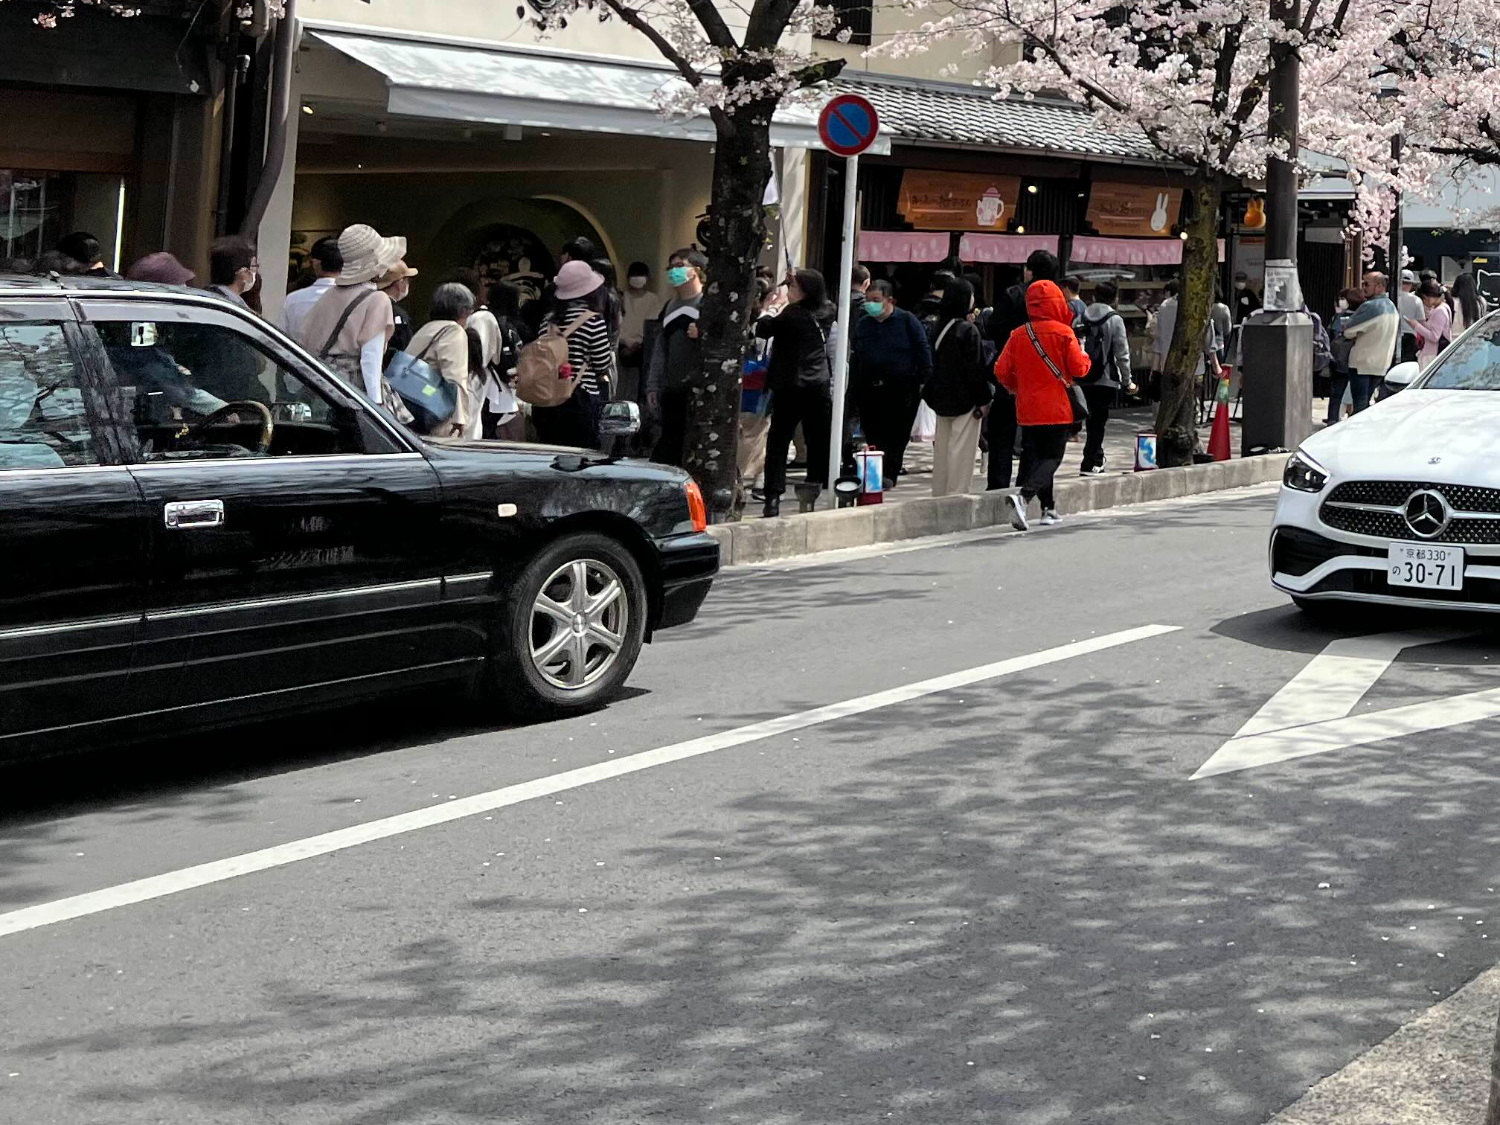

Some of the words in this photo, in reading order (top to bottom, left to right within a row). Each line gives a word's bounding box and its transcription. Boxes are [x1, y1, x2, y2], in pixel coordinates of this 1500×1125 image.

[1406, 548, 1446, 561] 京都330
[1392, 565, 1401, 576] の
[1404, 561, 1455, 586] 30-71
